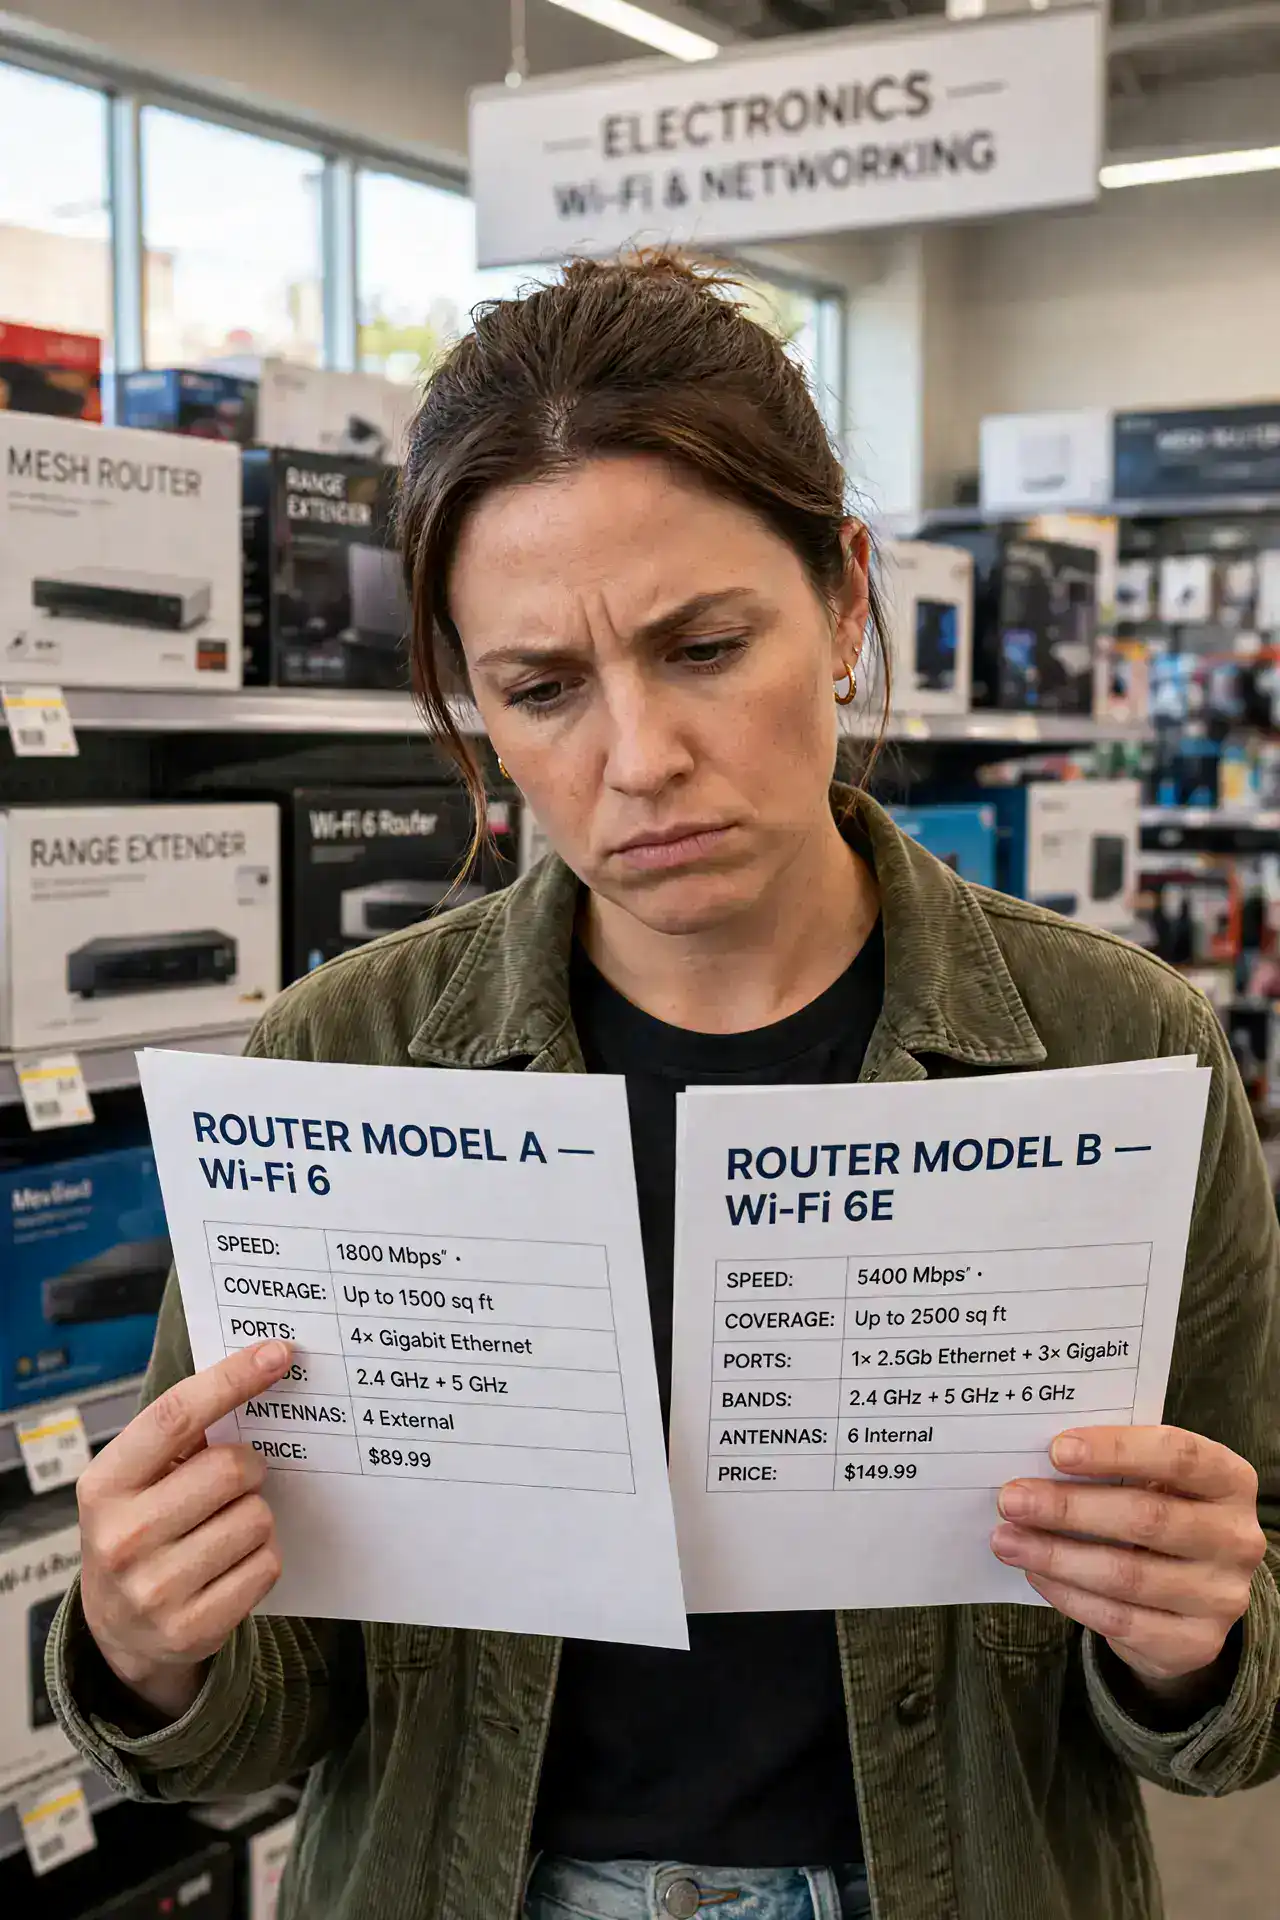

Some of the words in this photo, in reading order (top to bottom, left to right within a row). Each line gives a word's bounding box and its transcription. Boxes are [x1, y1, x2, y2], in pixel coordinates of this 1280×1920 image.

[602, 71, 933, 161] ELECTRONICS
[663, 165, 691, 208] &
[701, 129, 997, 203] NETWORKING
[7, 445, 90, 486] MESH
[98, 457, 202, 498] ROUTER
[362, 809, 377, 838] 6
[378, 811, 438, 838] Router
[30, 834, 121, 868] RANGE
[127, 831, 247, 862] EXTENDER
[192, 1111, 352, 1153] ROUTER
[361, 1122, 508, 1162] MODEL
[519, 1131, 548, 1164] A
[727, 1141, 900, 1180] ROUTER
[913, 1135, 1063, 1174] MODEL
[1076, 1133, 1102, 1166] B
[198, 1157, 297, 1194] Wi-Fi
[307, 1164, 331, 1196] 6
[725, 1191, 830, 1226] Wi-Fi
[843, 1189, 895, 1223] 6E
[217, 1235, 280, 1255] SPEED:
[336, 1243, 383, 1263] 1800
[726, 1271, 794, 1289] SPEED:
[857, 1268, 907, 1285] 5400
[224, 1277, 327, 1300] COVERAGE:
[343, 1285, 369, 1307] Up
[374, 1289, 394, 1305] to
[398, 1289, 445, 1308] 1500
[452, 1296, 474, 1314] sq
[478, 1293, 495, 1311] ft
[725, 1311, 835, 1330] COVERAGE:
[855, 1309, 881, 1330] Up
[886, 1310, 905, 1326] to
[910, 1307, 960, 1325] 2500
[965, 1309, 987, 1327] sq
[992, 1305, 1007, 1322] ft
[231, 1319, 296, 1340] PORTS:
[379, 1329, 447, 1351] Gigabit
[451, 1333, 533, 1355] Ethernet
[723, 1353, 791, 1369] PORTS:
[877, 1349, 932, 1367] 2.5Gb
[938, 1347, 1017, 1365] Ethernet
[1022, 1350, 1033, 1360] +
[1066, 1340, 1129, 1363] Gigabit
[356, 1368, 386, 1386] 2.4
[390, 1371, 430, 1390] GHz
[435, 1377, 446, 1388] +
[452, 1374, 463, 1391] 5
[469, 1376, 509, 1394] GHz
[722, 1391, 792, 1408] BANDS:
[849, 1389, 877, 1406] 2.4
[883, 1389, 922, 1405] GHz
[928, 1391, 939, 1402] +
[944, 1388, 955, 1404] 5
[961, 1387, 999, 1403] GHz
[1005, 1390, 1016, 1400] +
[1021, 1385, 1033, 1401] 6
[1038, 1384, 1075, 1401] GHz
[245, 1401, 346, 1423] ANTENNAS:
[362, 1409, 374, 1425] 4
[379, 1410, 455, 1431] External
[719, 1428, 827, 1445] ANTENNAS:
[847, 1427, 859, 1443] 6
[864, 1427, 933, 1443] Internal
[251, 1440, 307, 1459] PRICE:
[368, 1447, 431, 1468] $89.99
[718, 1466, 777, 1481] PRICE:
[844, 1462, 917, 1481] $149.99
